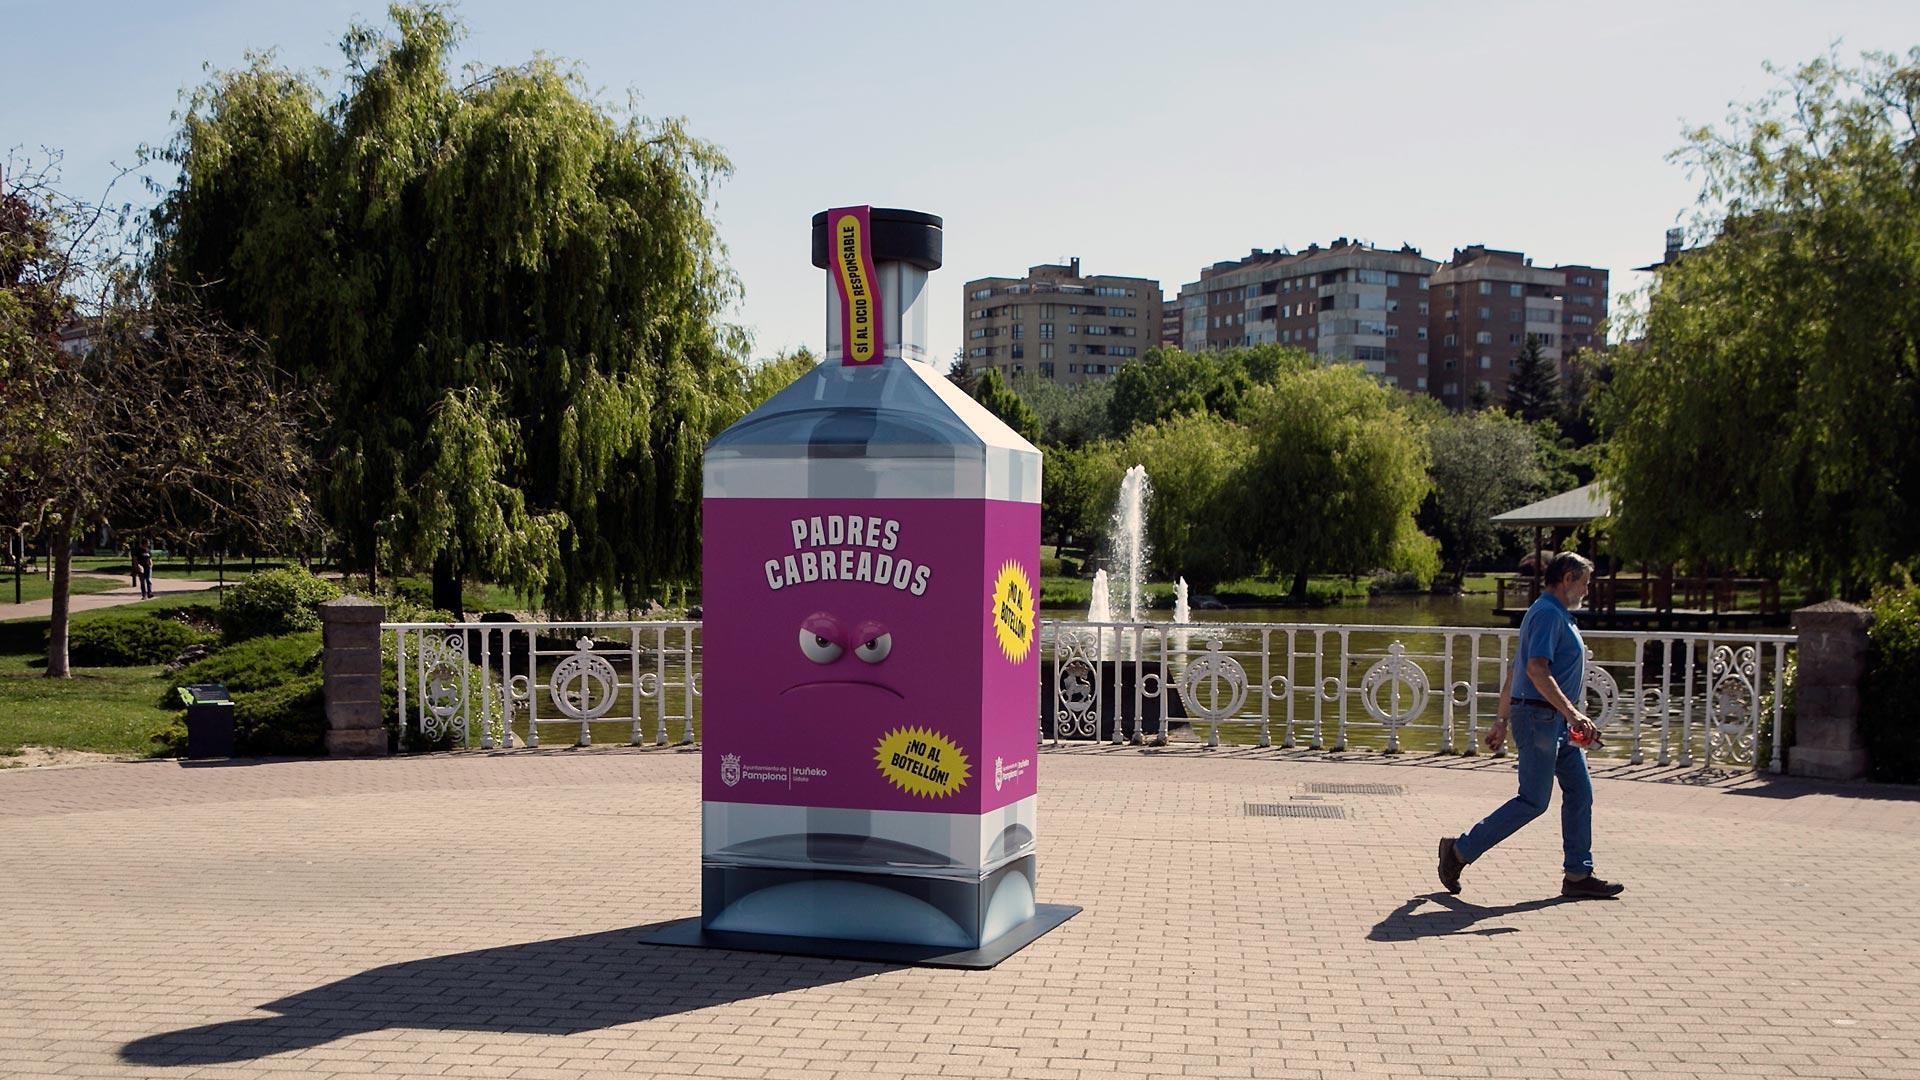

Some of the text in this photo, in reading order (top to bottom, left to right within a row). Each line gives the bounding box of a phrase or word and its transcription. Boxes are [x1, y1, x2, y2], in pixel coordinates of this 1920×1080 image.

[843, 226, 868, 353] SÍ AL OCIO RESPONSABLE
[791, 515, 900, 551] PADRES
[764, 550, 931, 596] CABREADOS
[905, 739, 941, 763] ¡NO AL
[743, 771, 787, 782] Pamplona
[793, 766, 828, 777] Iruñeko
[891, 752, 950, 786] BOTELLÓN!
